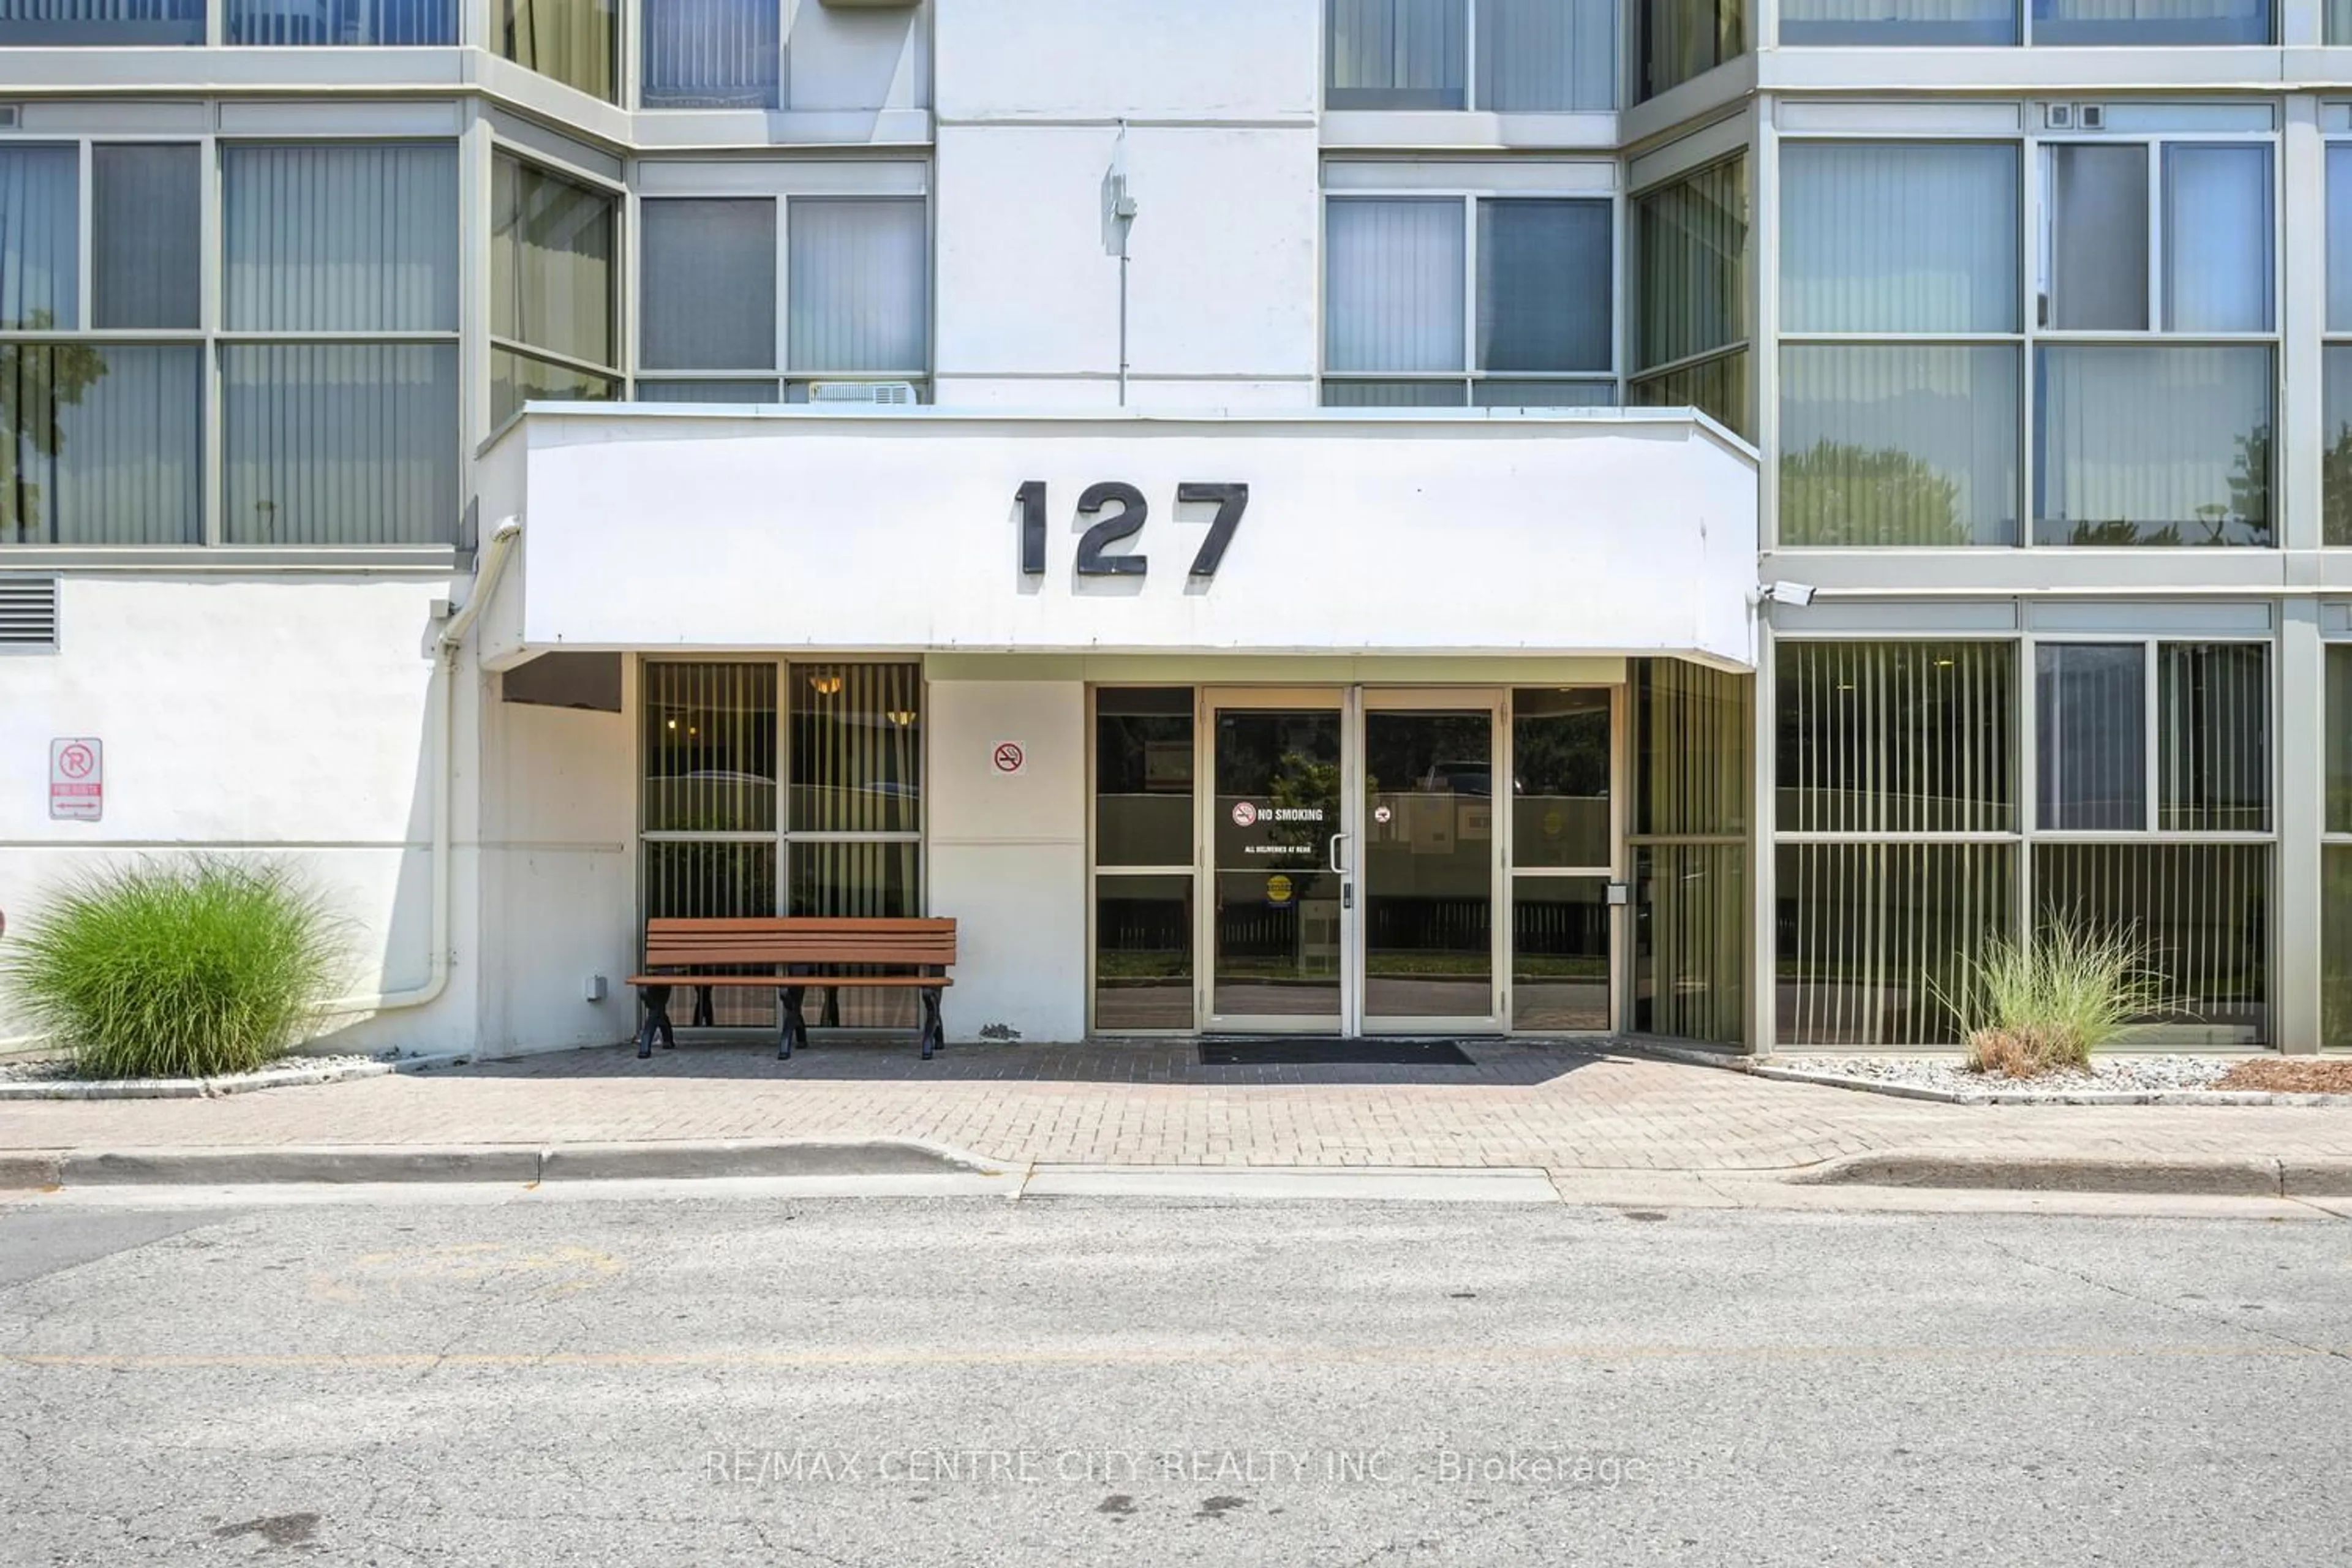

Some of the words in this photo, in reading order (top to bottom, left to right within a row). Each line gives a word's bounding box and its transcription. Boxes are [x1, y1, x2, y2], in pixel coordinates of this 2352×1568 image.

[1015, 481, 1249, 576] 127
[1257, 809, 1273, 821] NO
[1275, 809, 1323, 821] SMOKING
